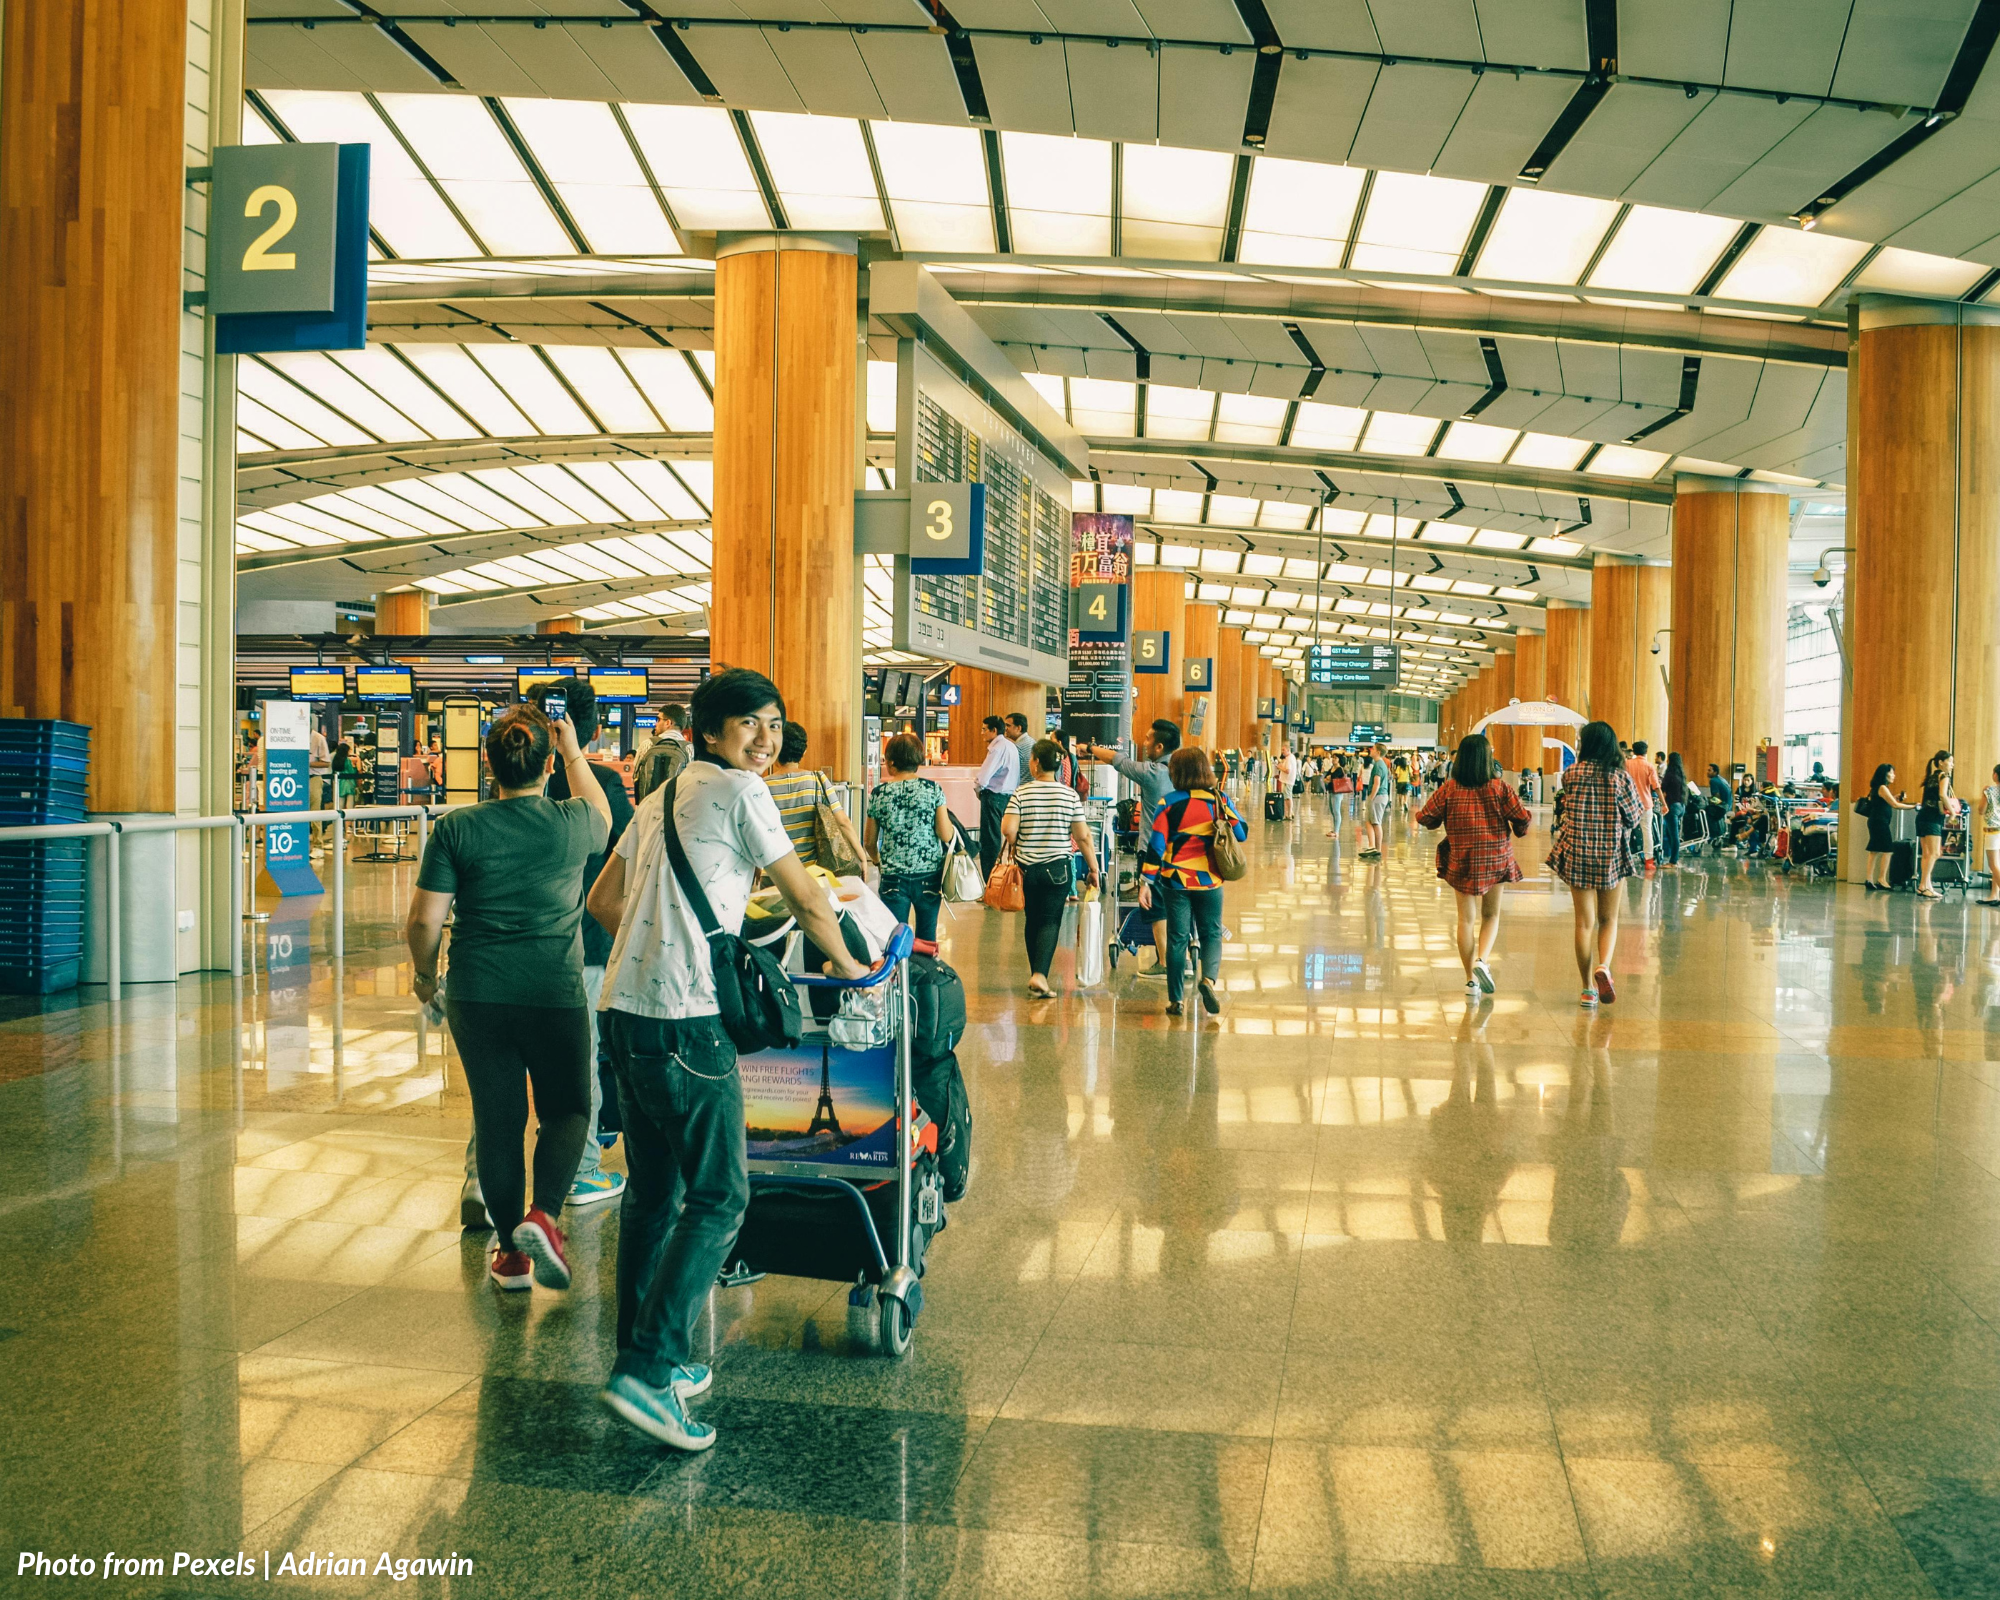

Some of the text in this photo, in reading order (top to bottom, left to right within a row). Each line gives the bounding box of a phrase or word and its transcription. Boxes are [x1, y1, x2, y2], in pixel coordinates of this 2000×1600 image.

[242, 185, 298, 271] 2
[983, 409, 1035, 465] DEPARTURES
[926, 500, 953, 540] 3
[1088, 594, 1107, 620] 4
[1141, 638, 1156, 659] 5
[1190, 664, 1202, 680] 6
[944, 686, 958, 703] 4
[1261, 701, 1269, 711] 7
[1274, 707, 1281, 717] 8
[1518, 705, 1556, 713] CHANGI
[1294, 712, 1300, 721] 9
[270, 727, 291, 735] ON-TIME
[269, 776, 296, 798] 60
[269, 832, 292, 854] 10
[741, 1064, 815, 1076] WIN FREE FLIGHTS
[762, 1076, 802, 1085] REWARDS
